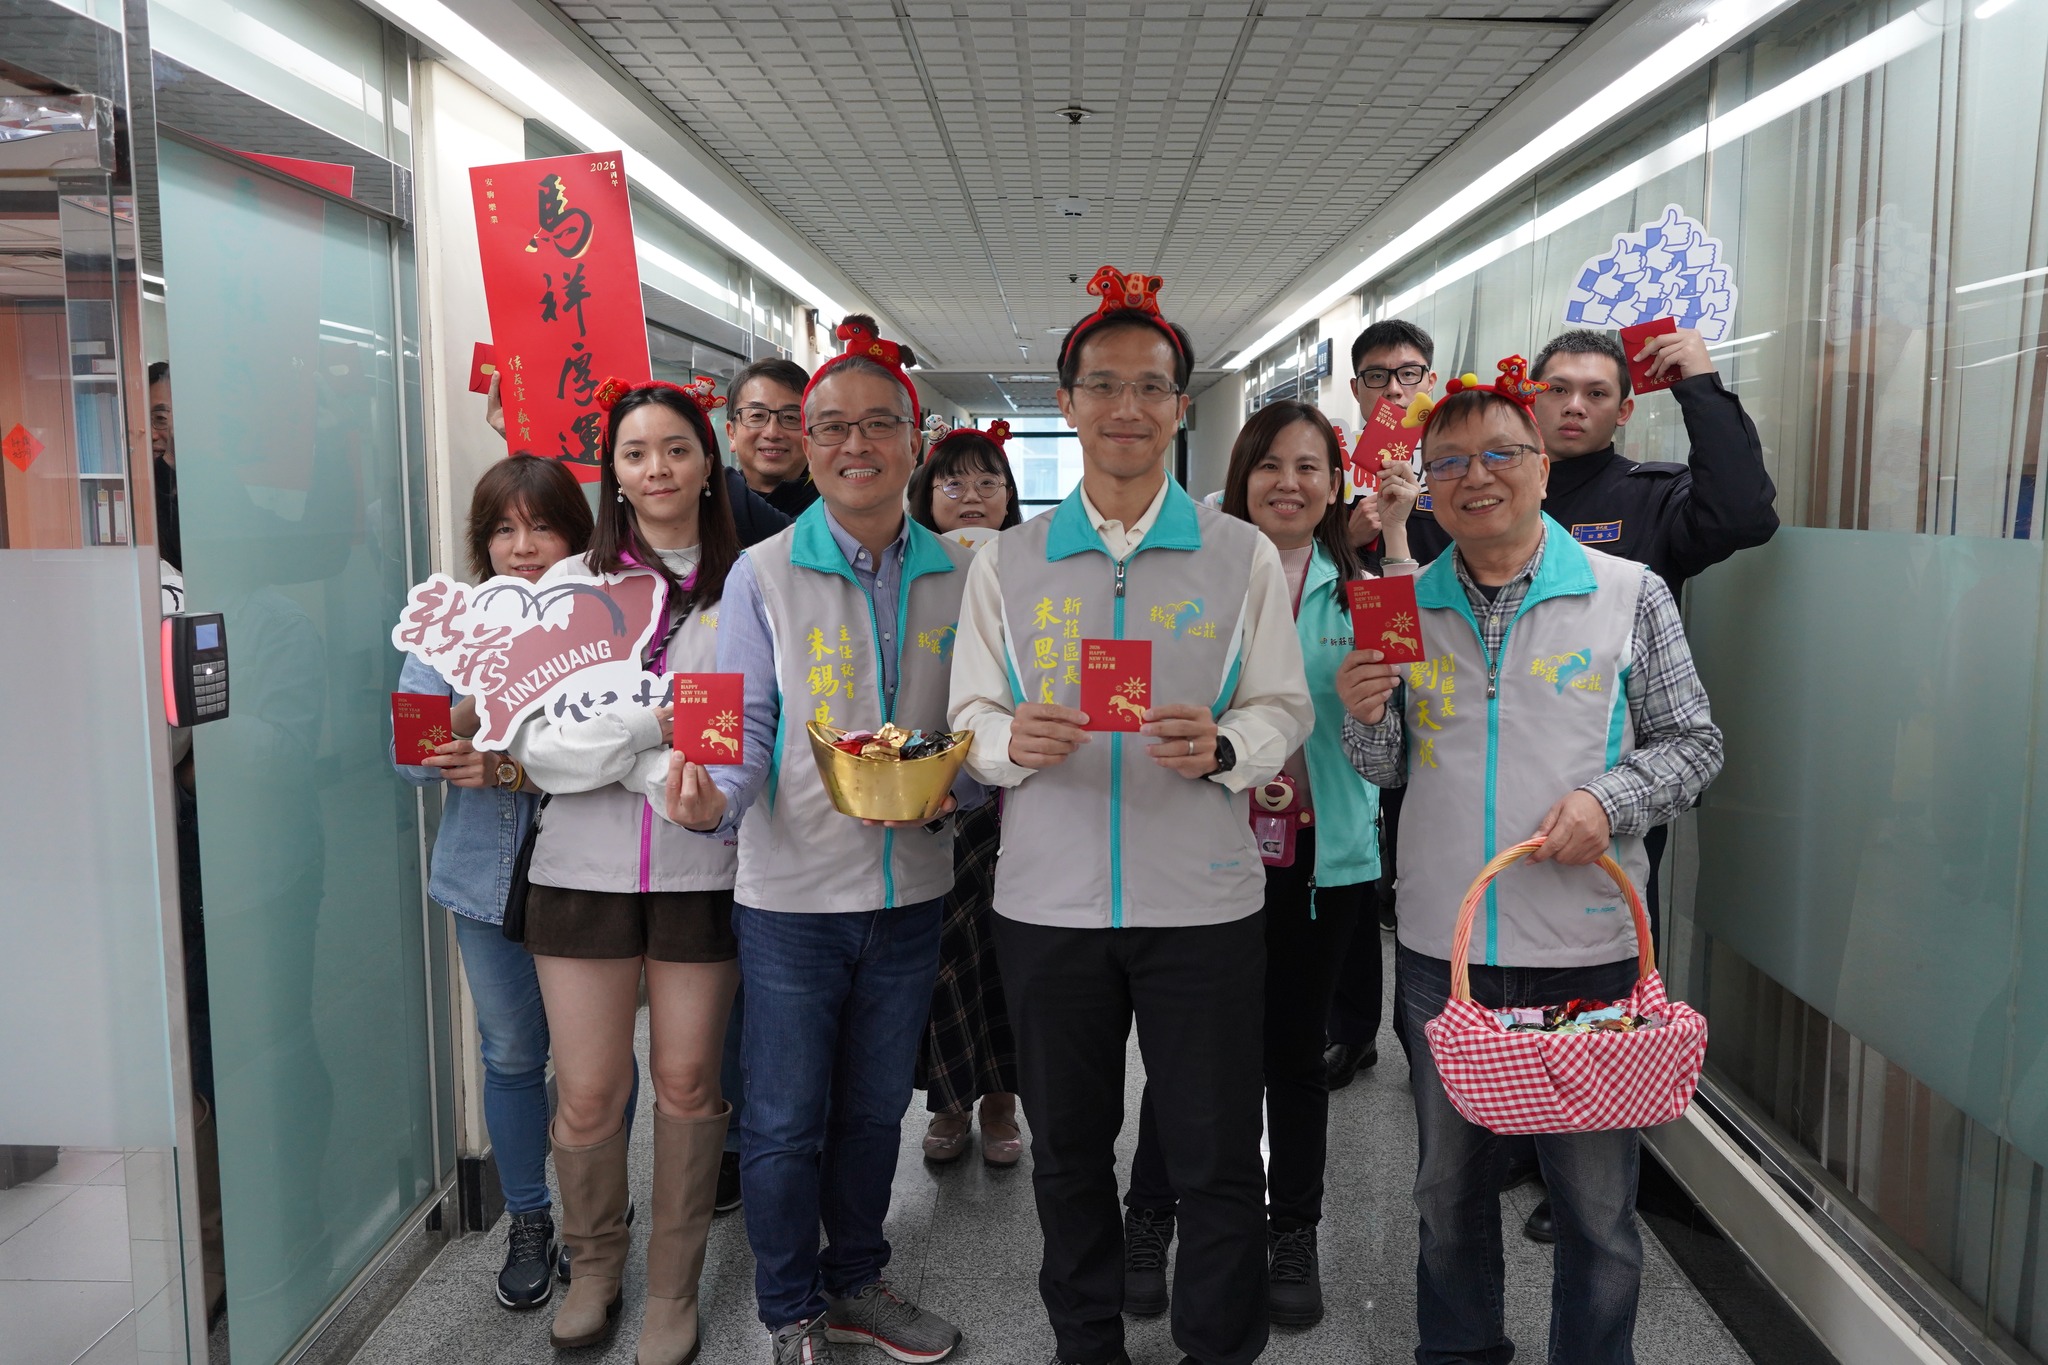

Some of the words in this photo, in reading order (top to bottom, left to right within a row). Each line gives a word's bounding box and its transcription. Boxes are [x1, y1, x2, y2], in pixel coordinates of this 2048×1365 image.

[590, 160, 616, 172] 2026
[610, 171, 618, 187] 丙午
[525, 173, 602, 467] 馬祥厚運
[497, 639, 612, 713] XINZHUANG
[806, 627, 839, 726] 朱錫良
[839, 624, 855, 699] 主任秘書
[1062, 597, 1082, 685] 新莊區長
[1440, 653, 1456, 717] 副區長
